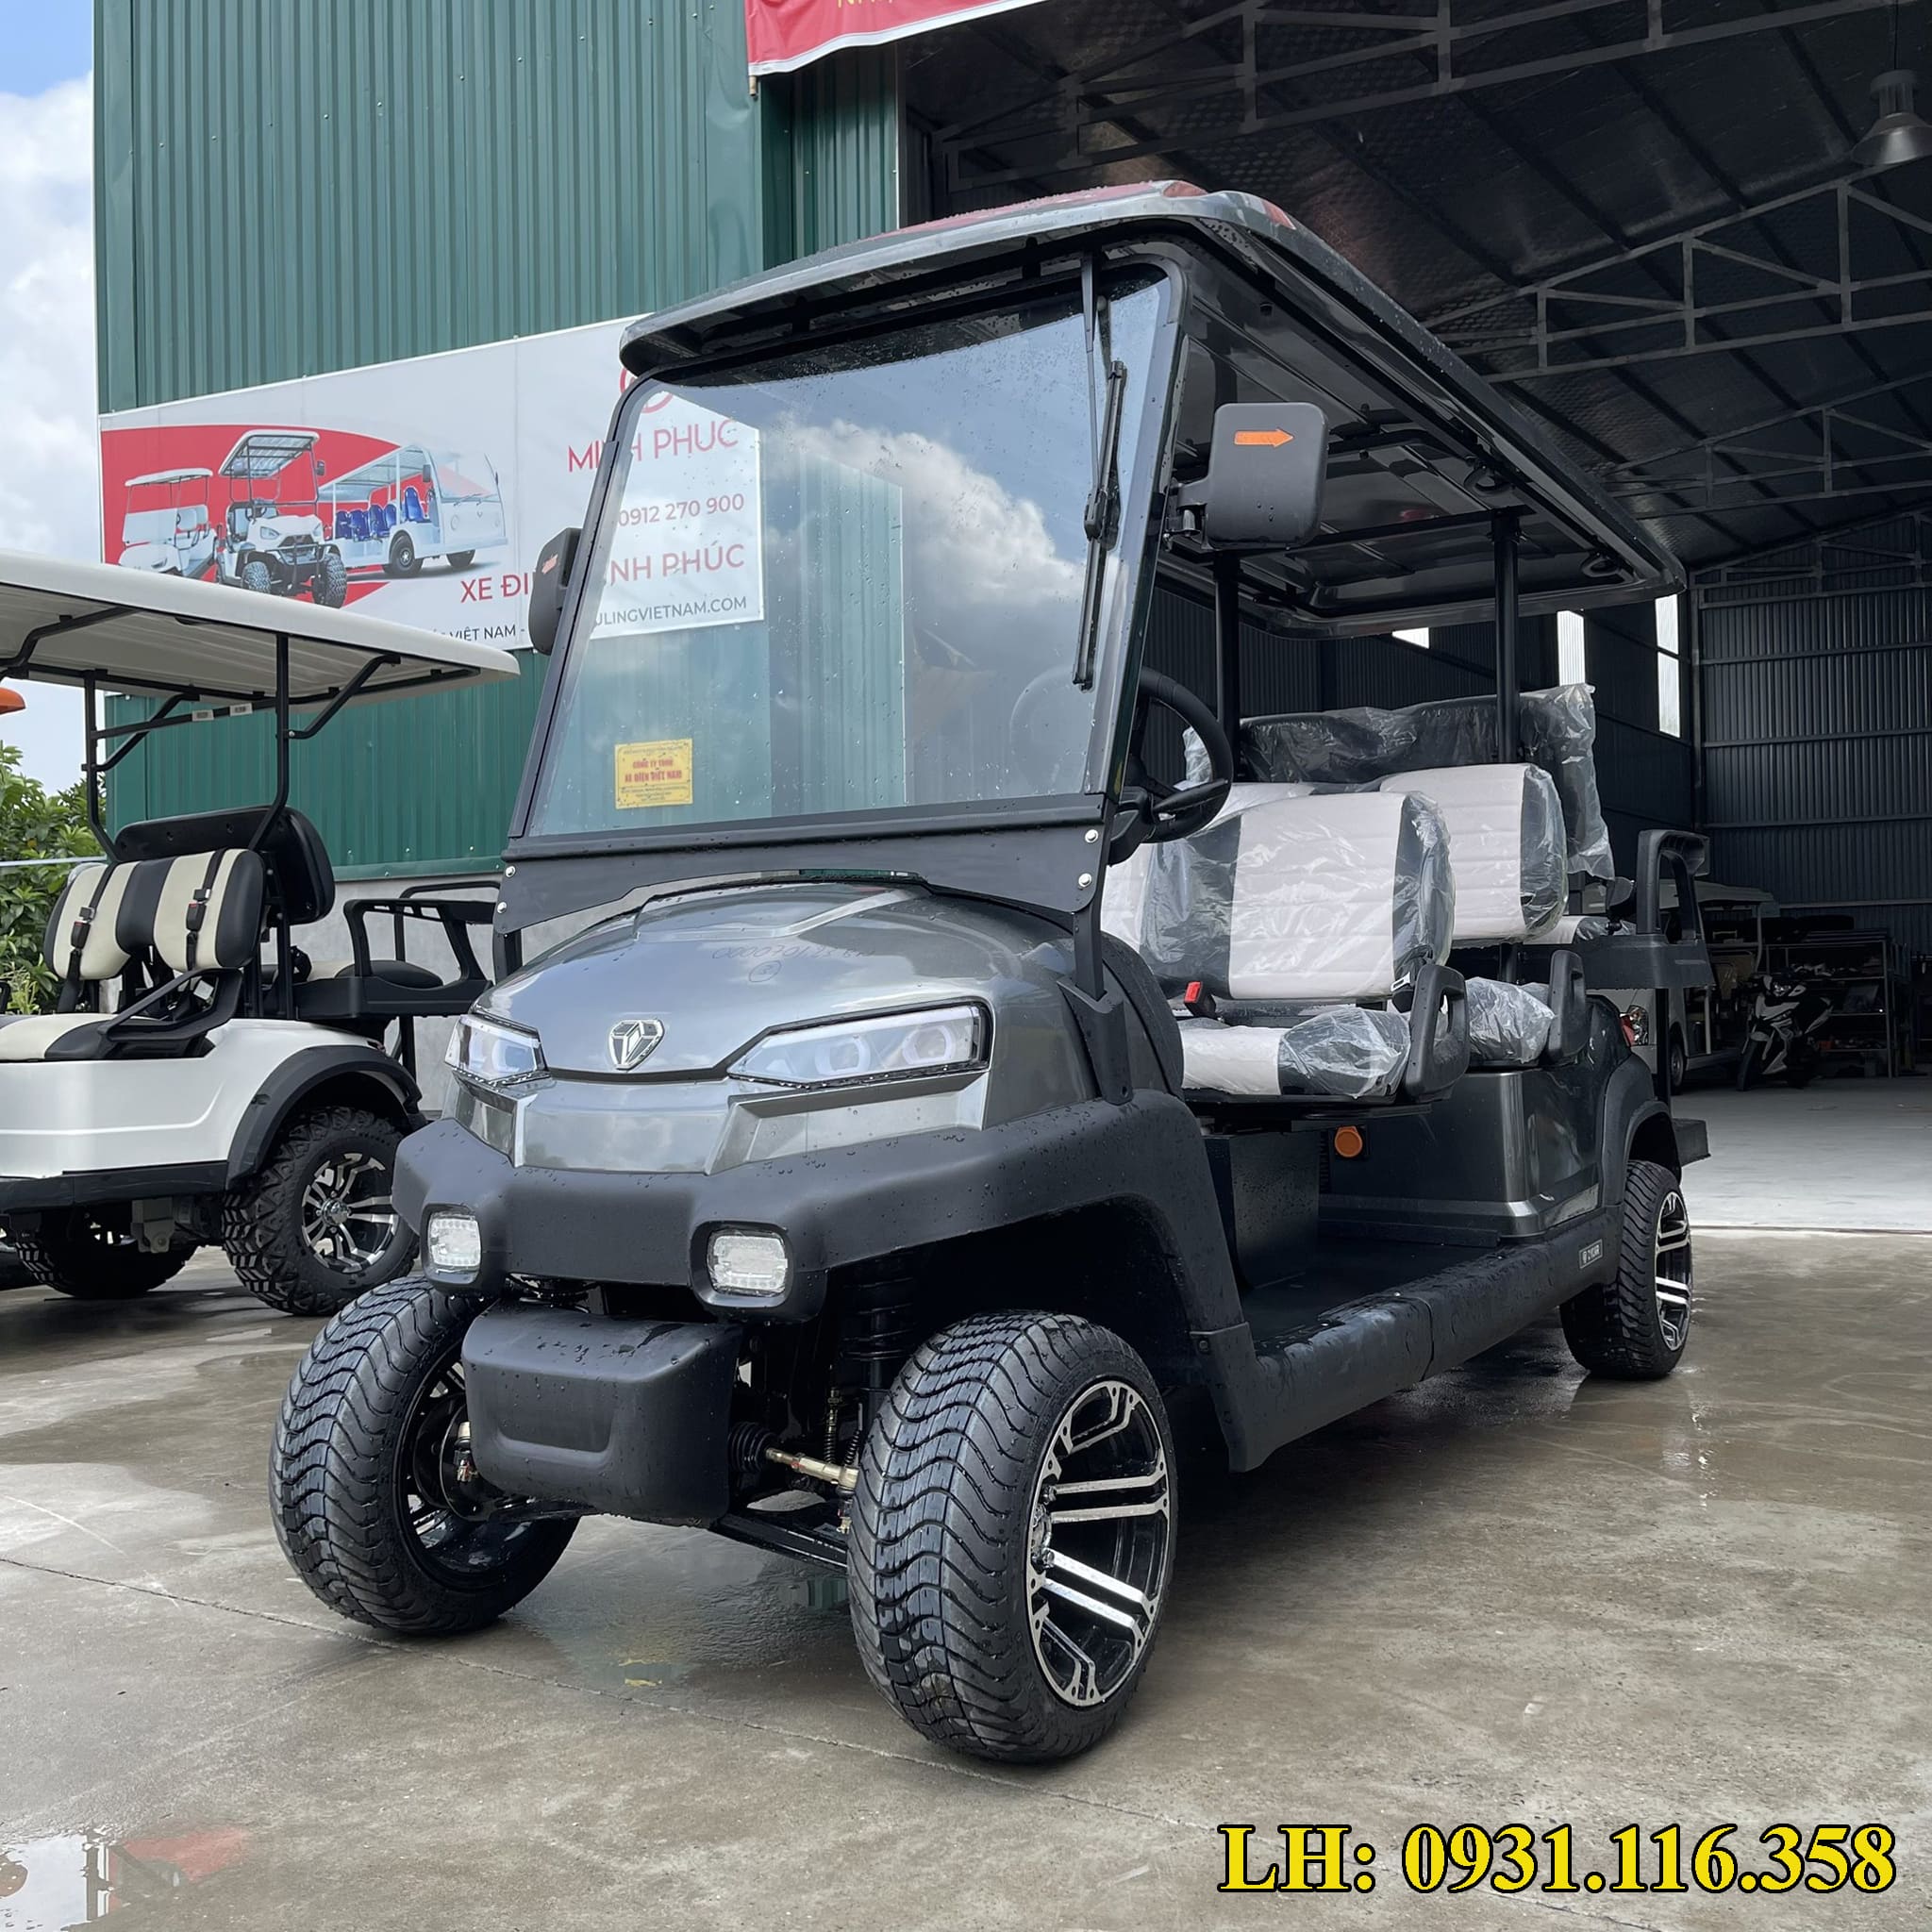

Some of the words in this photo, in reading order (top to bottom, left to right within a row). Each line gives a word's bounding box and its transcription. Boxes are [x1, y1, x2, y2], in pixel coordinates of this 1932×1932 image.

[568, 433, 642, 472] MIH
[618, 506, 660, 526] 0912
[665, 500, 701, 521] 270
[706, 493, 745, 515] 900
[460, 576, 493, 603] XE
[500, 573, 529, 597] ĐI
[610, 555, 652, 586] NH
[662, 540, 745, 577] PHÚC
[484, 625, 516, 640] NAM
[595, 596, 747, 626] ULINGVIETNAM.COM
